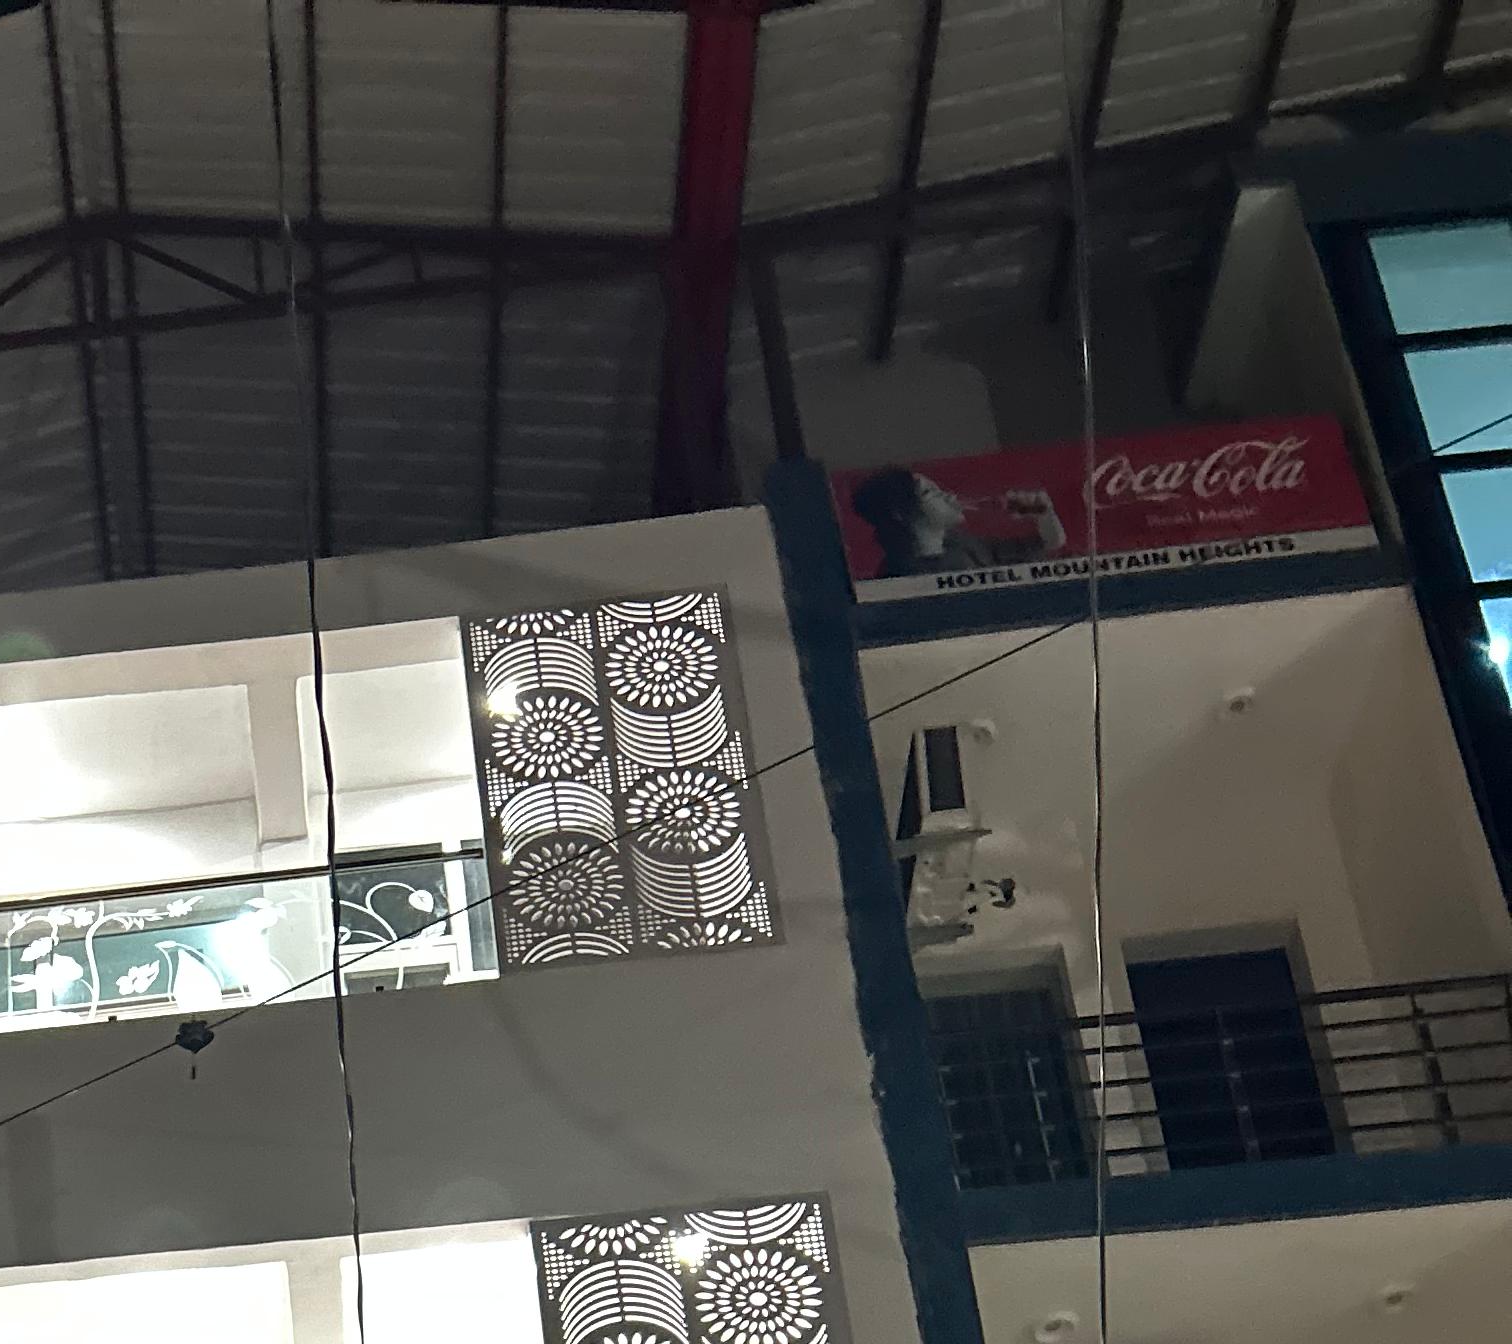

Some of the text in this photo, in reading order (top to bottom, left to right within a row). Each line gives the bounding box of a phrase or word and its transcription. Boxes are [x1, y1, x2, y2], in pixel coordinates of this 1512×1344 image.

[1084, 435, 1310, 509] Coca-Cola
[936, 537, 1296, 589] HOTEL MOUNTAIN HEIGHTS
